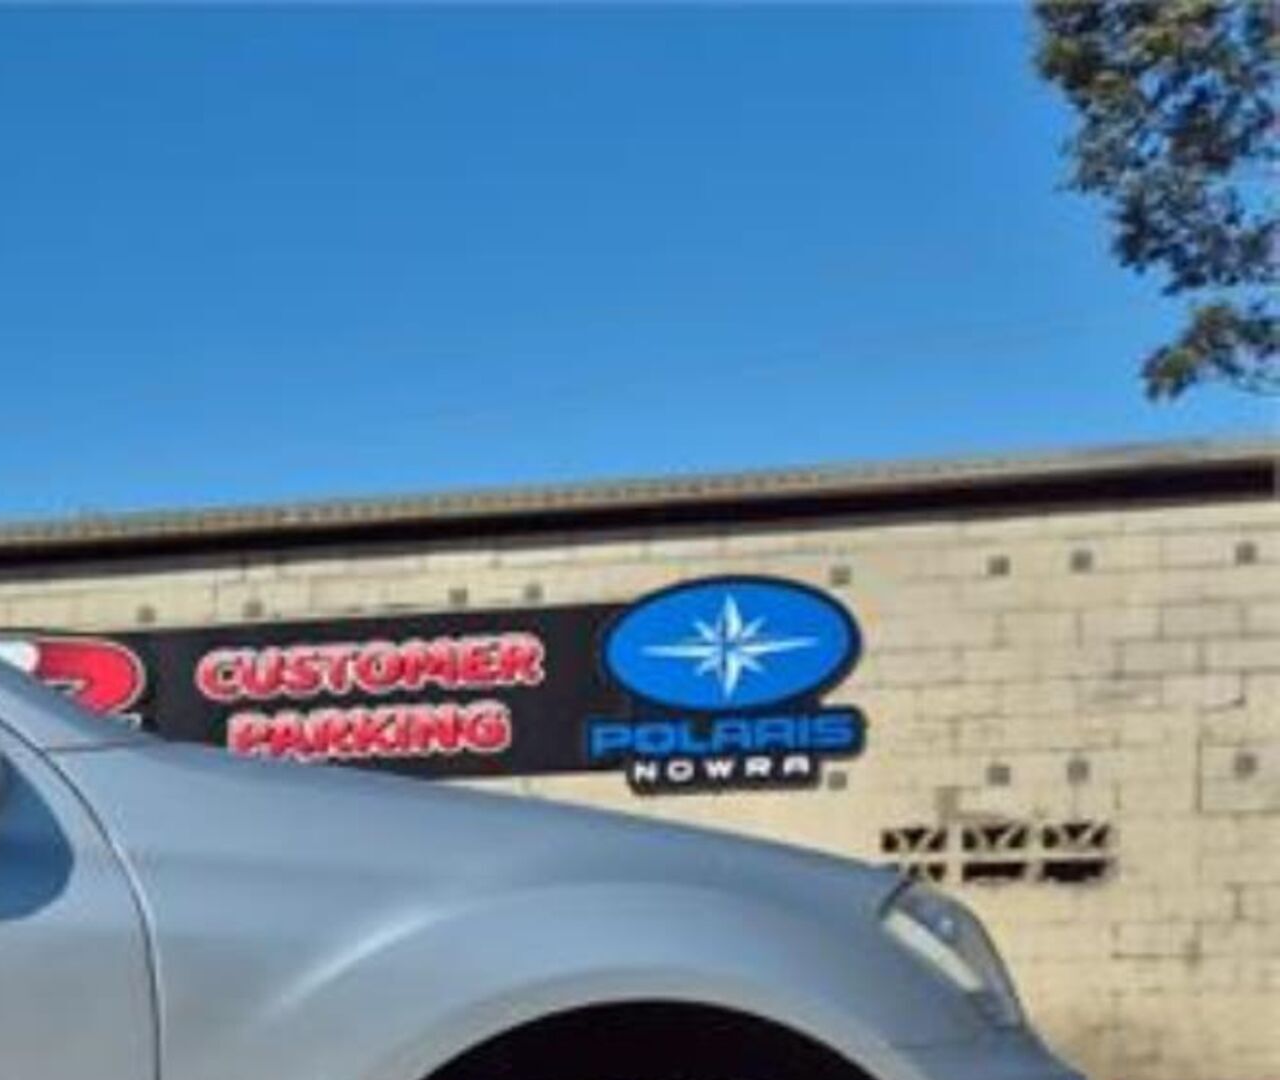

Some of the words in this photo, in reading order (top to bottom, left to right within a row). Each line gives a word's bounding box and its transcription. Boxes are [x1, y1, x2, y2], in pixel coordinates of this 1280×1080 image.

[196, 632, 544, 700] CUSTOMER
[227, 699, 512, 763] PARKING
[590, 711, 854, 758] POLARIS
[634, 754, 811, 783] NOWRA
